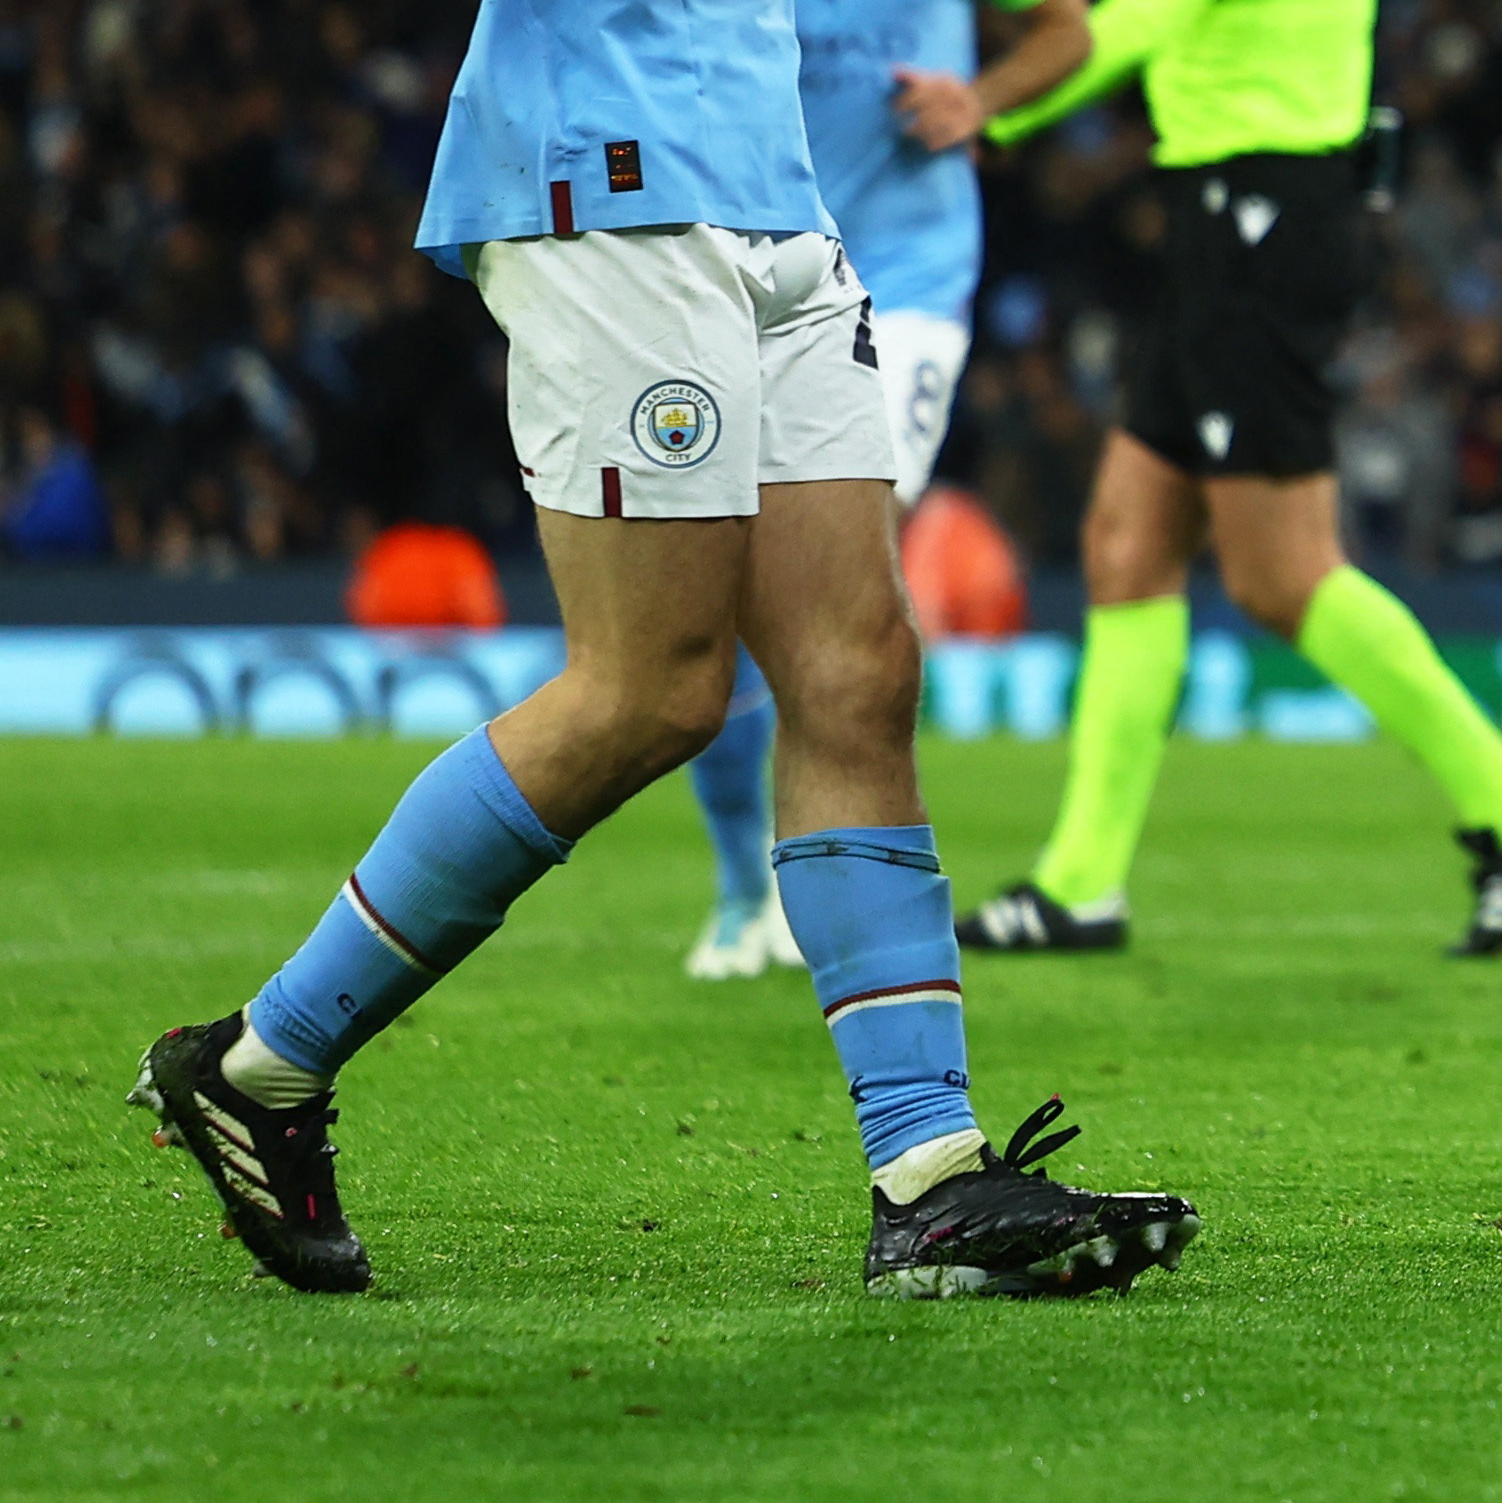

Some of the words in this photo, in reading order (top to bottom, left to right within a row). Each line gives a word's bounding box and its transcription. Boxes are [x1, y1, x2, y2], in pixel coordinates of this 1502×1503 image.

[640, 387, 711, 416] MANCHESTER
[665, 453, 692, 463] CITY
[943, 1069, 970, 1089] CI
